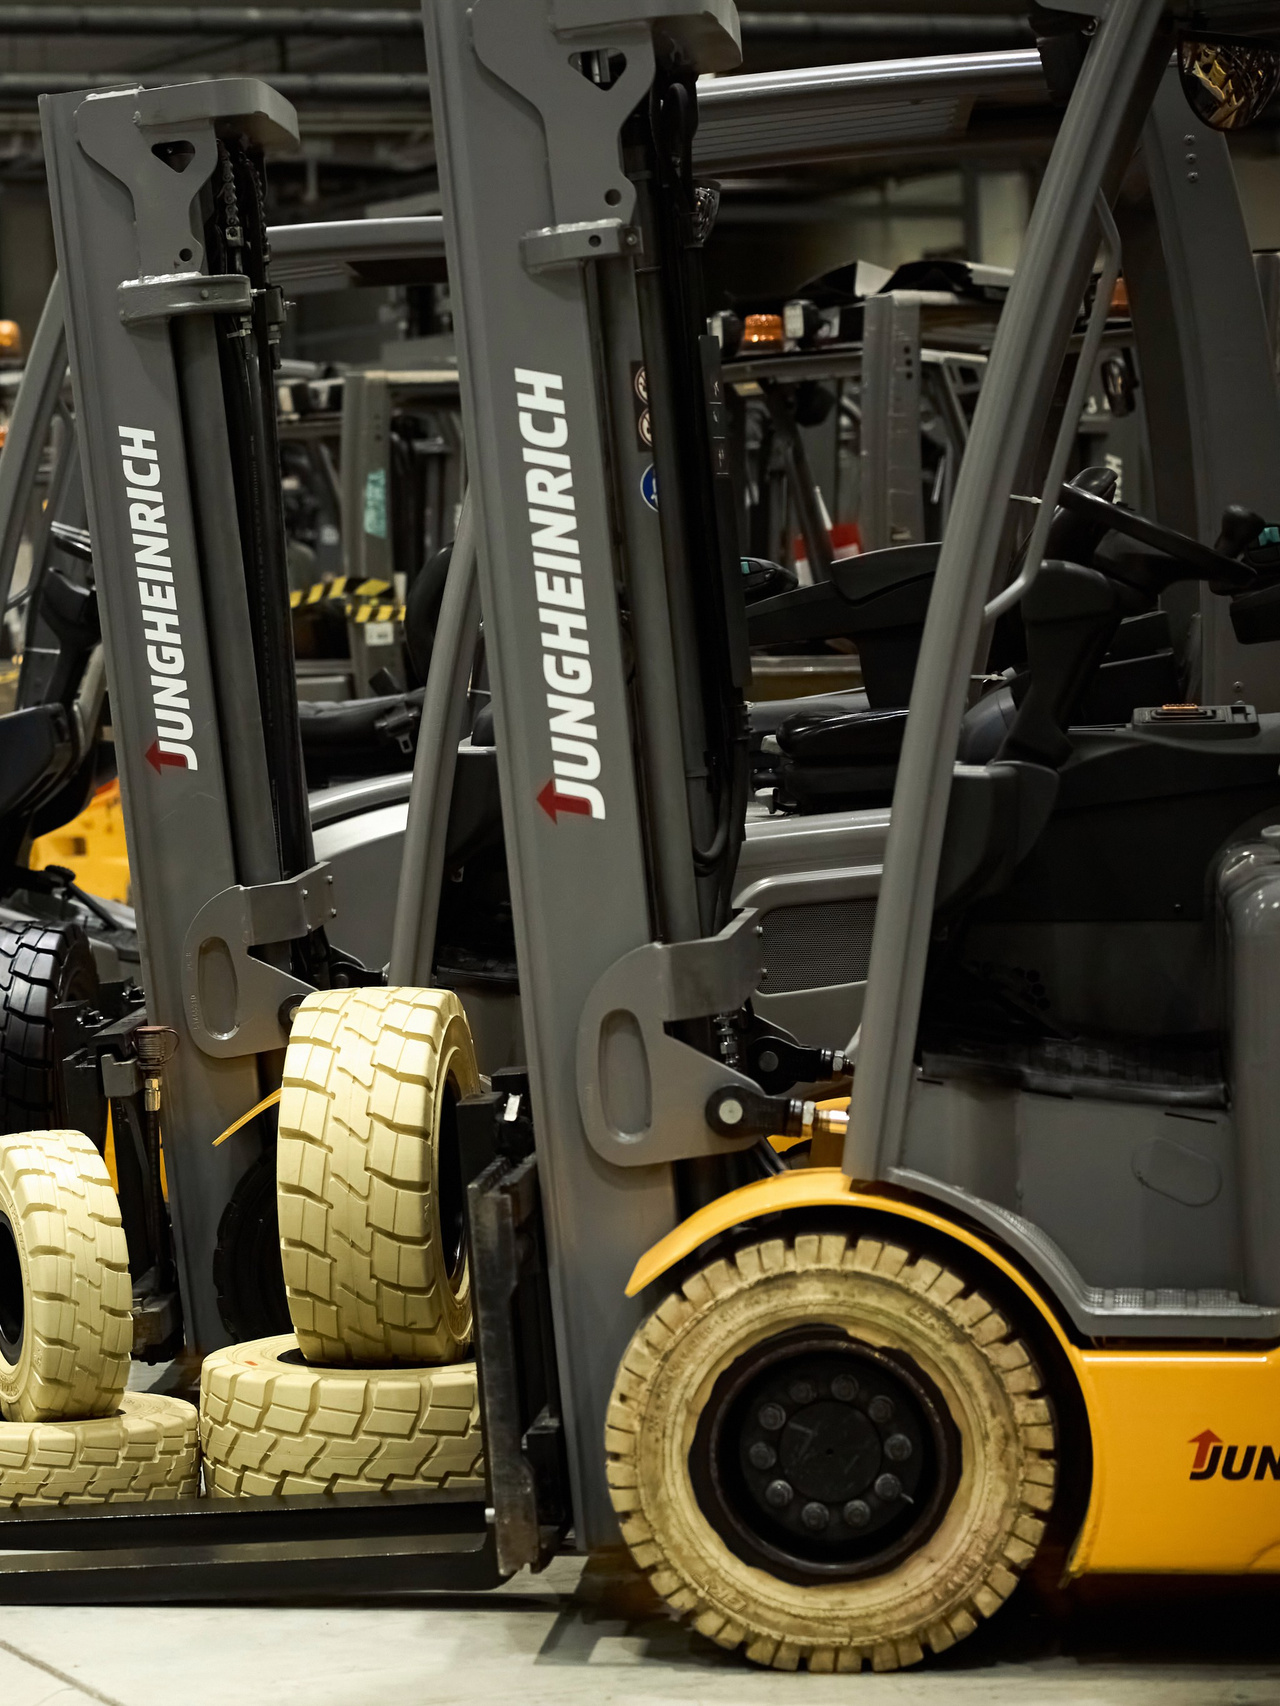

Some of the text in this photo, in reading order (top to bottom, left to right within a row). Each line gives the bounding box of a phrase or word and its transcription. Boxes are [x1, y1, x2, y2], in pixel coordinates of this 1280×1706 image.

[118, 425, 198, 771] JUNGHEINRICH
[514, 367, 606, 820] JUNGHEINRICH
[1189, 1444, 1280, 1481] JUN
